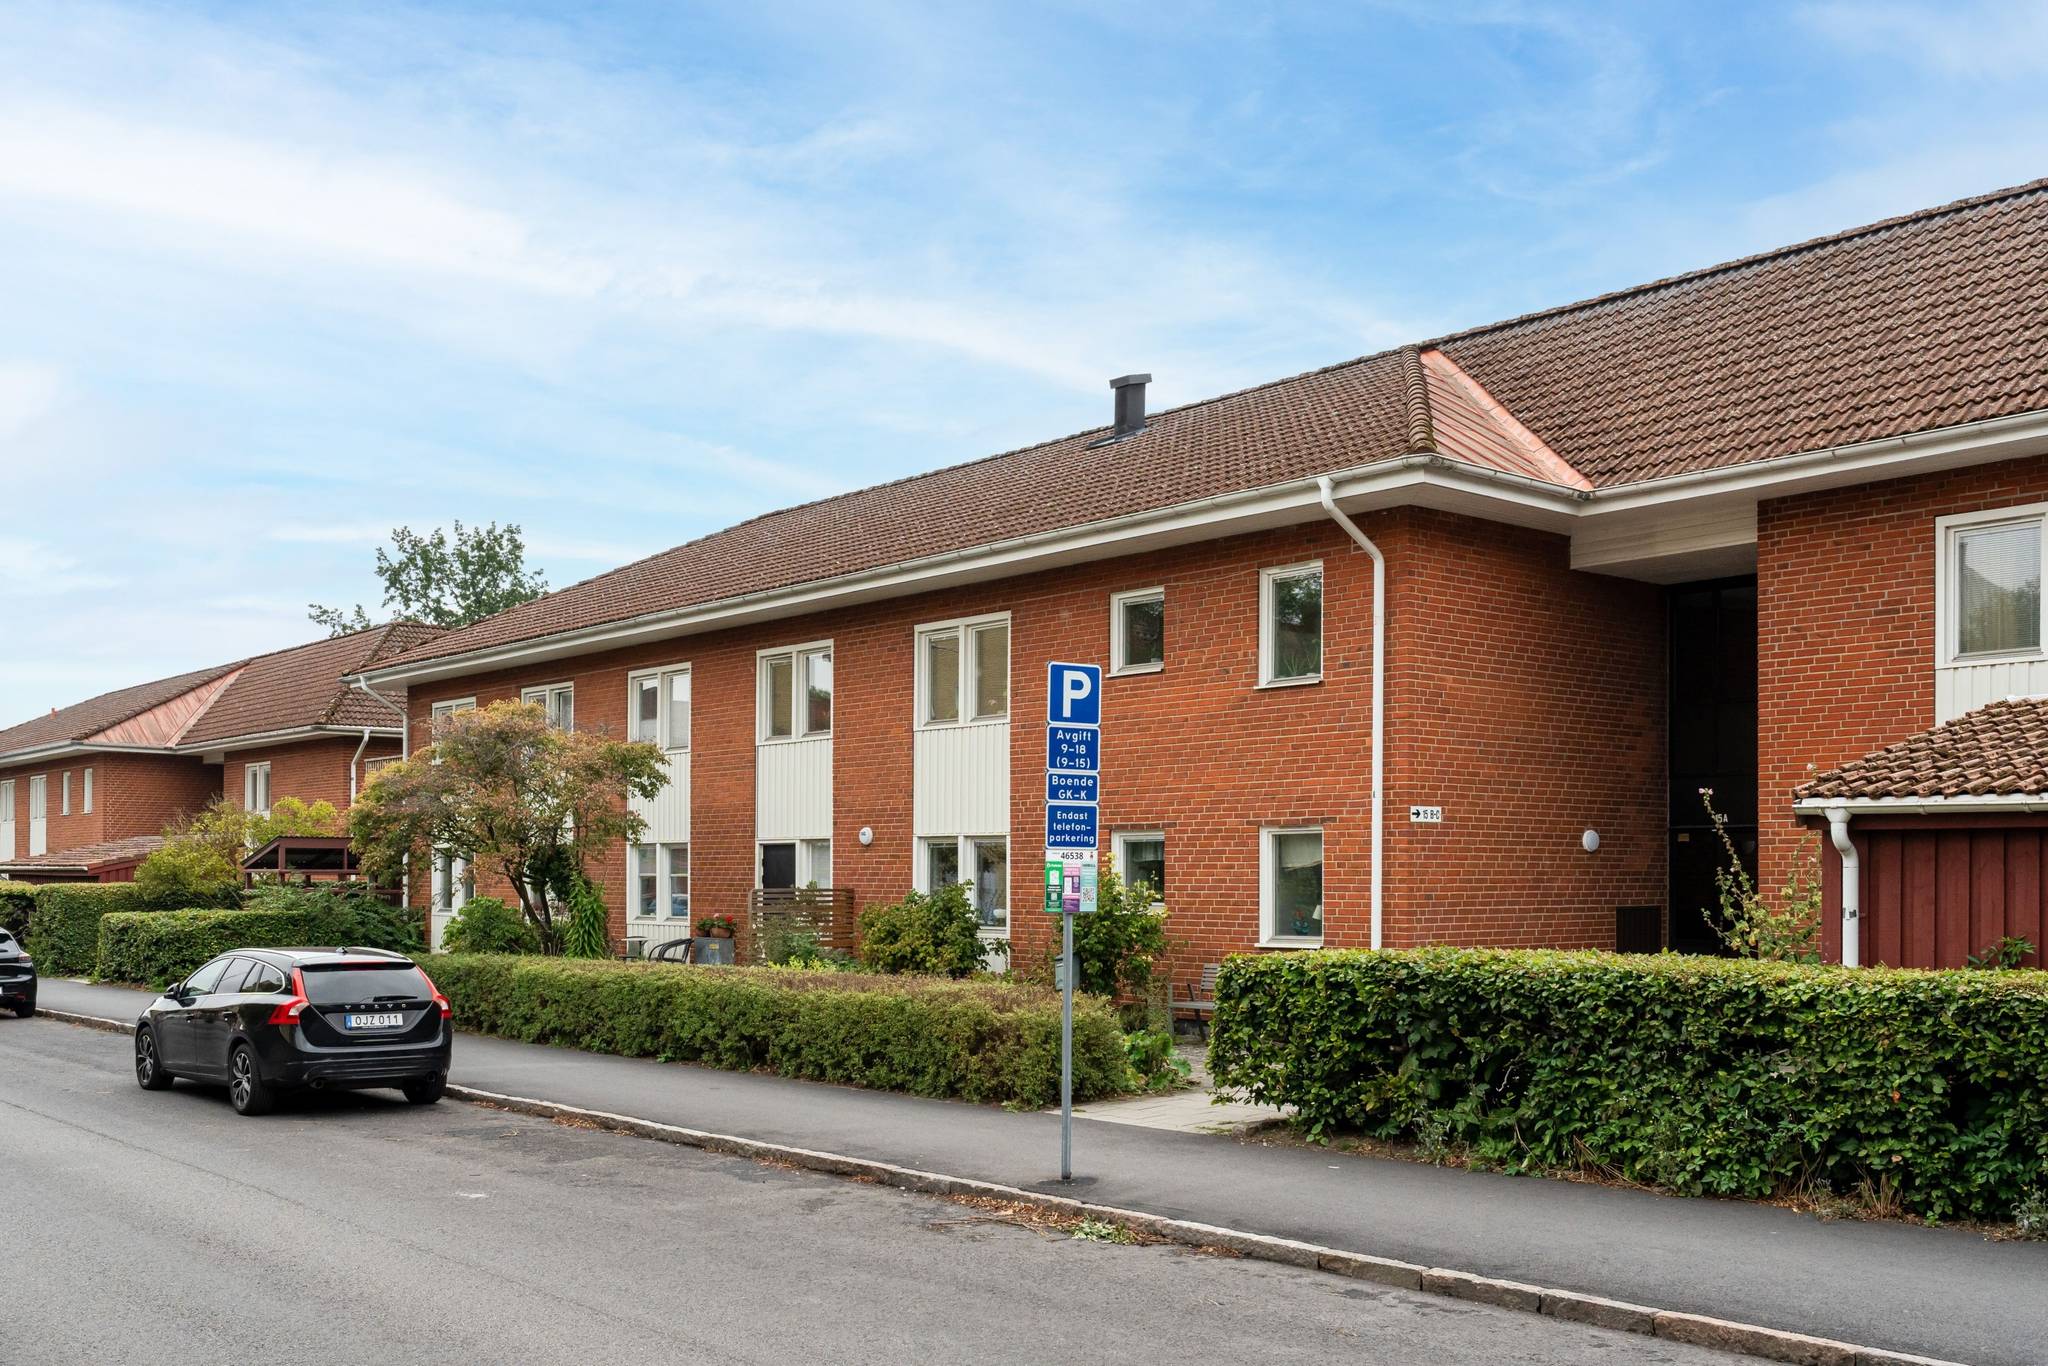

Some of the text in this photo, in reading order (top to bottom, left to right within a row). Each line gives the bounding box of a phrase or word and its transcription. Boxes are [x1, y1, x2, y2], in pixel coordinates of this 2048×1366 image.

[1062, 669, 1092, 718] P
[1056, 729, 1091, 743] Avgift
[1060, 743, 1086, 754] 9-18
[1056, 756, 1090, 769] (9-15)
[1052, 775, 1094, 787] Boende
[1058, 789, 1087, 800] GK-K
[1056, 811, 1088, 820] Endast
[1053, 821, 1092, 831] telefon-
[1049, 833, 1095, 845] parkering
[1060, 851, 1084, 860] 46538
